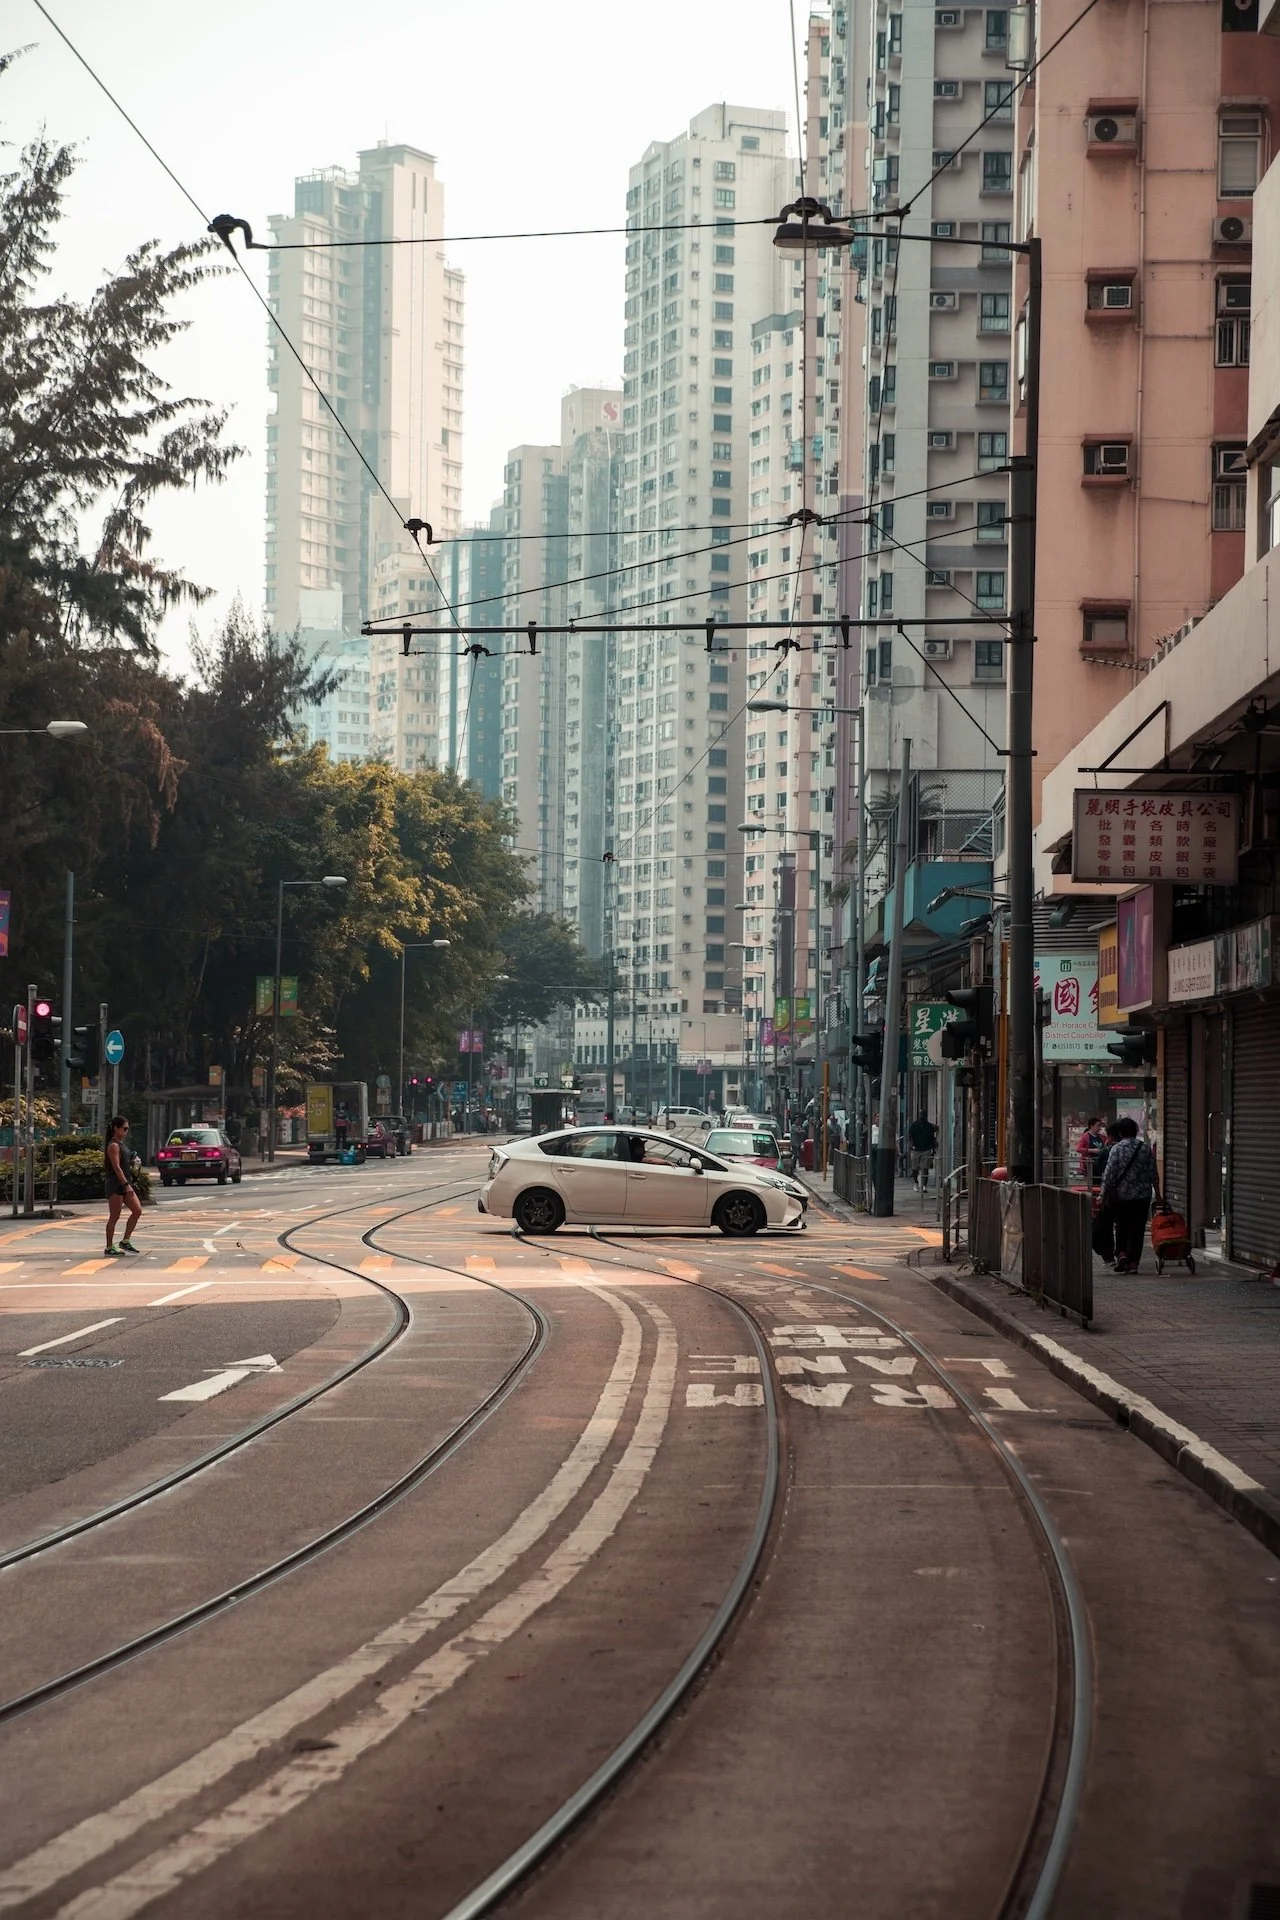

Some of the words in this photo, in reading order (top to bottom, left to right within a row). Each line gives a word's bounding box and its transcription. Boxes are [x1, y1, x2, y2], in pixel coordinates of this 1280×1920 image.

[1085, 798, 1232, 818] 麗明手袋皮具公司
[1097, 819, 1112, 877] 批發零售
[1148, 820, 1163, 877] 各類皮具
[1176, 820, 1190, 878] 時款銀包
[1202, 820, 1217, 879] 名廠手袋
[688, 1355, 1016, 1378] LANE
[685, 1383, 1057, 1413] TRAM
